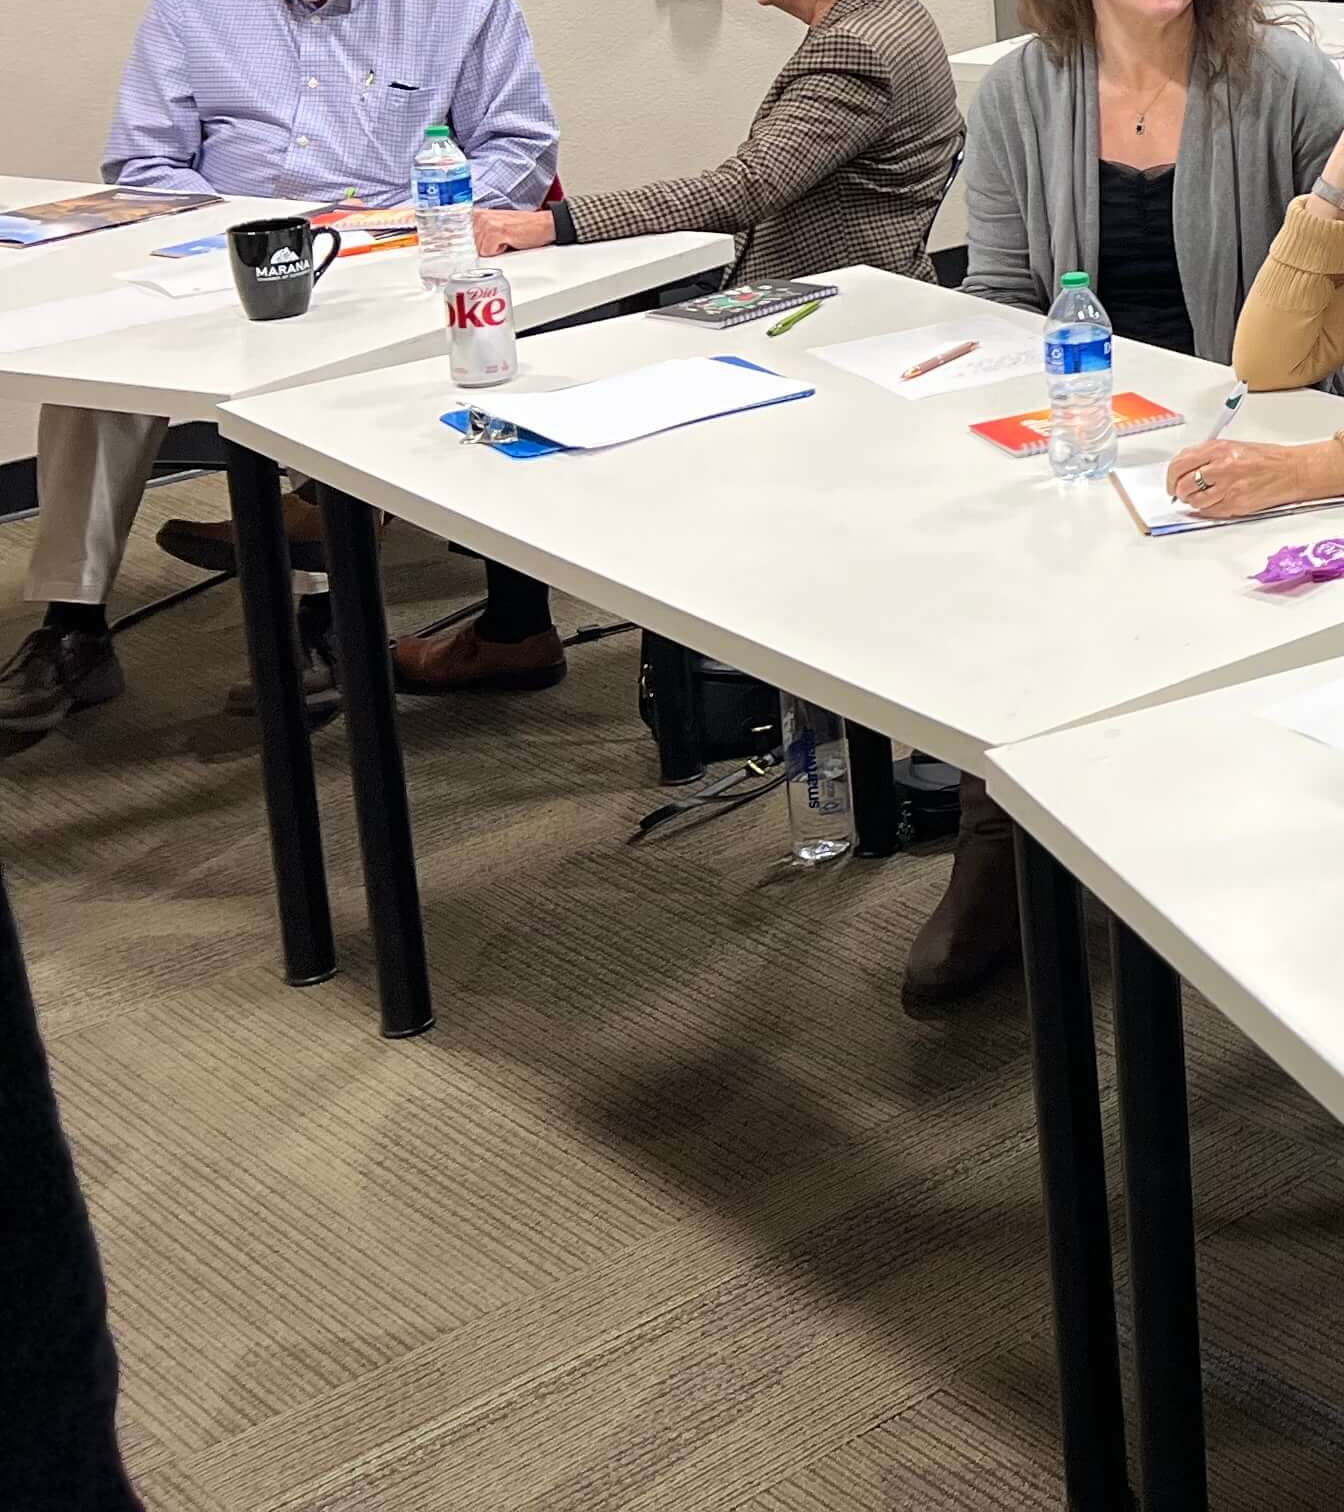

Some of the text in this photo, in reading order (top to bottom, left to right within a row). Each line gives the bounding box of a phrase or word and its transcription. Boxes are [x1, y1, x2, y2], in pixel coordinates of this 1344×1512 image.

[256, 259, 311, 278] MARANA
[466, 287, 498, 300] Diet
[447, 292, 507, 328] ke
